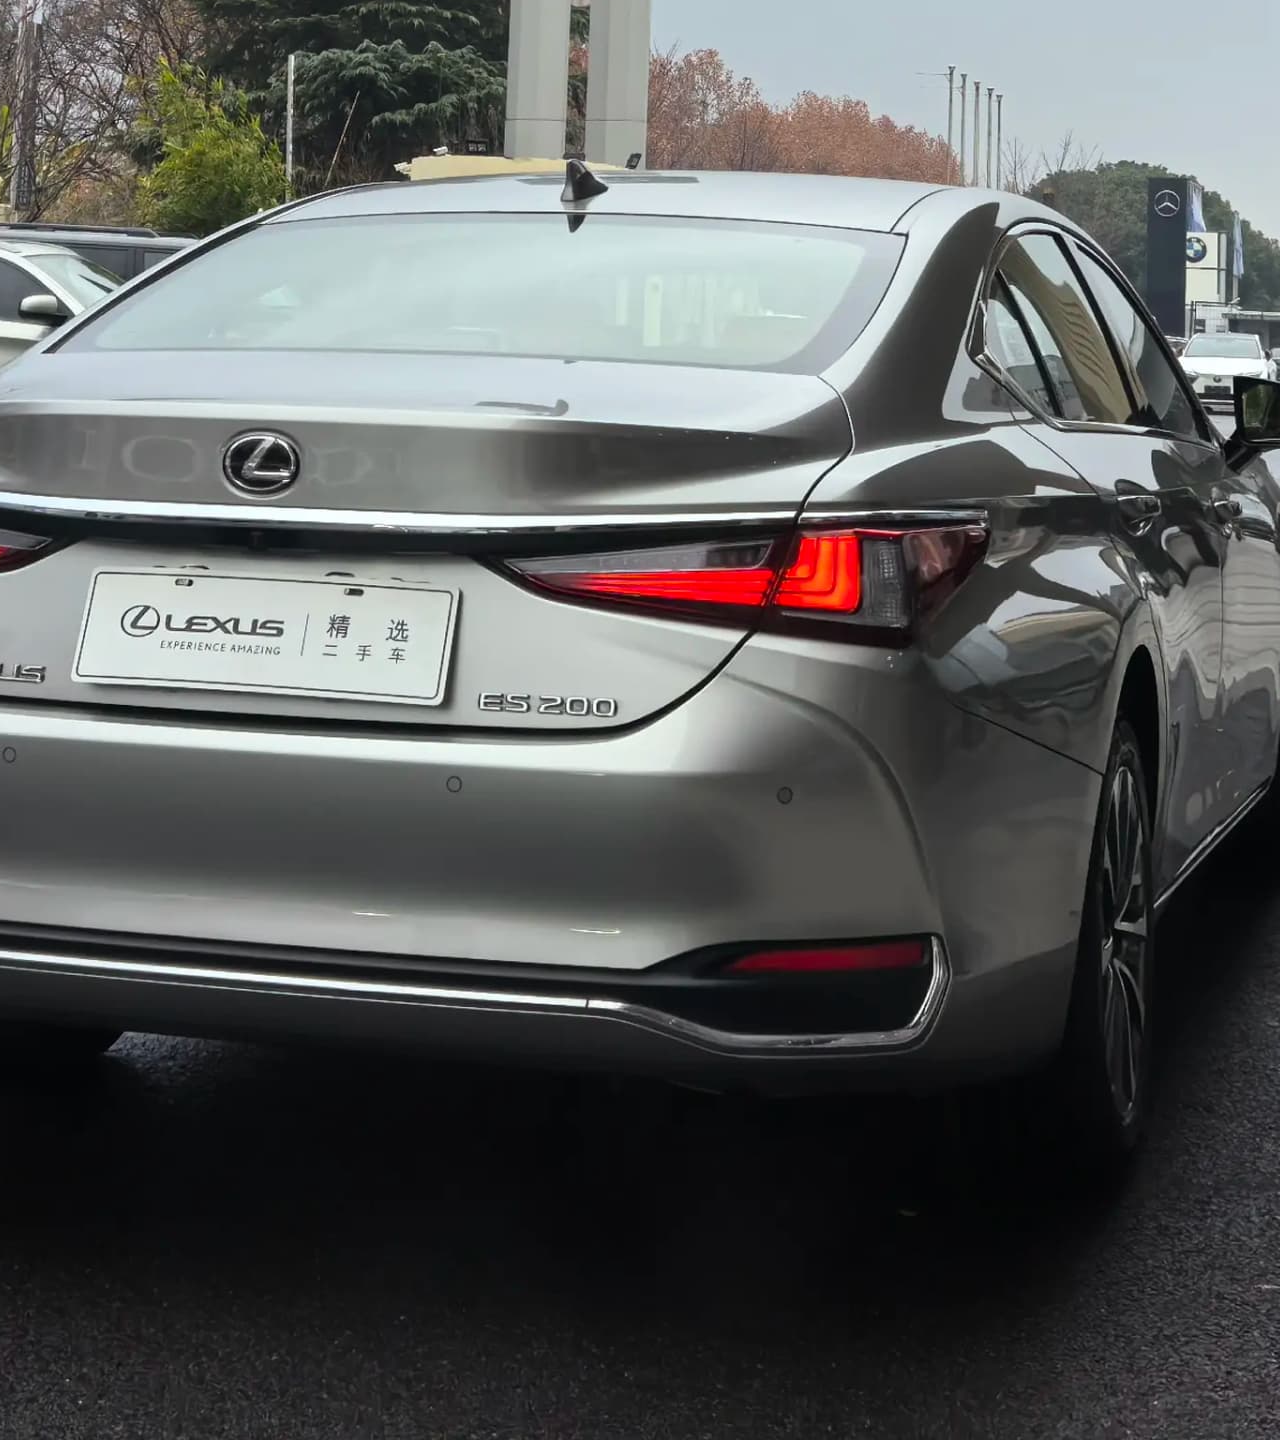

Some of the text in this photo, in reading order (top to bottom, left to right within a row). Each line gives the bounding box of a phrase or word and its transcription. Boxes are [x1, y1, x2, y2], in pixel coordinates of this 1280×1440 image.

[165, 613, 285, 638] LEXUS
[326, 613, 409, 642] 精选
[160, 640, 281, 656] EXPERIENCE AMAZING
[322, 644, 406, 665] 二手车
[478, 691, 618, 717] ES 200
